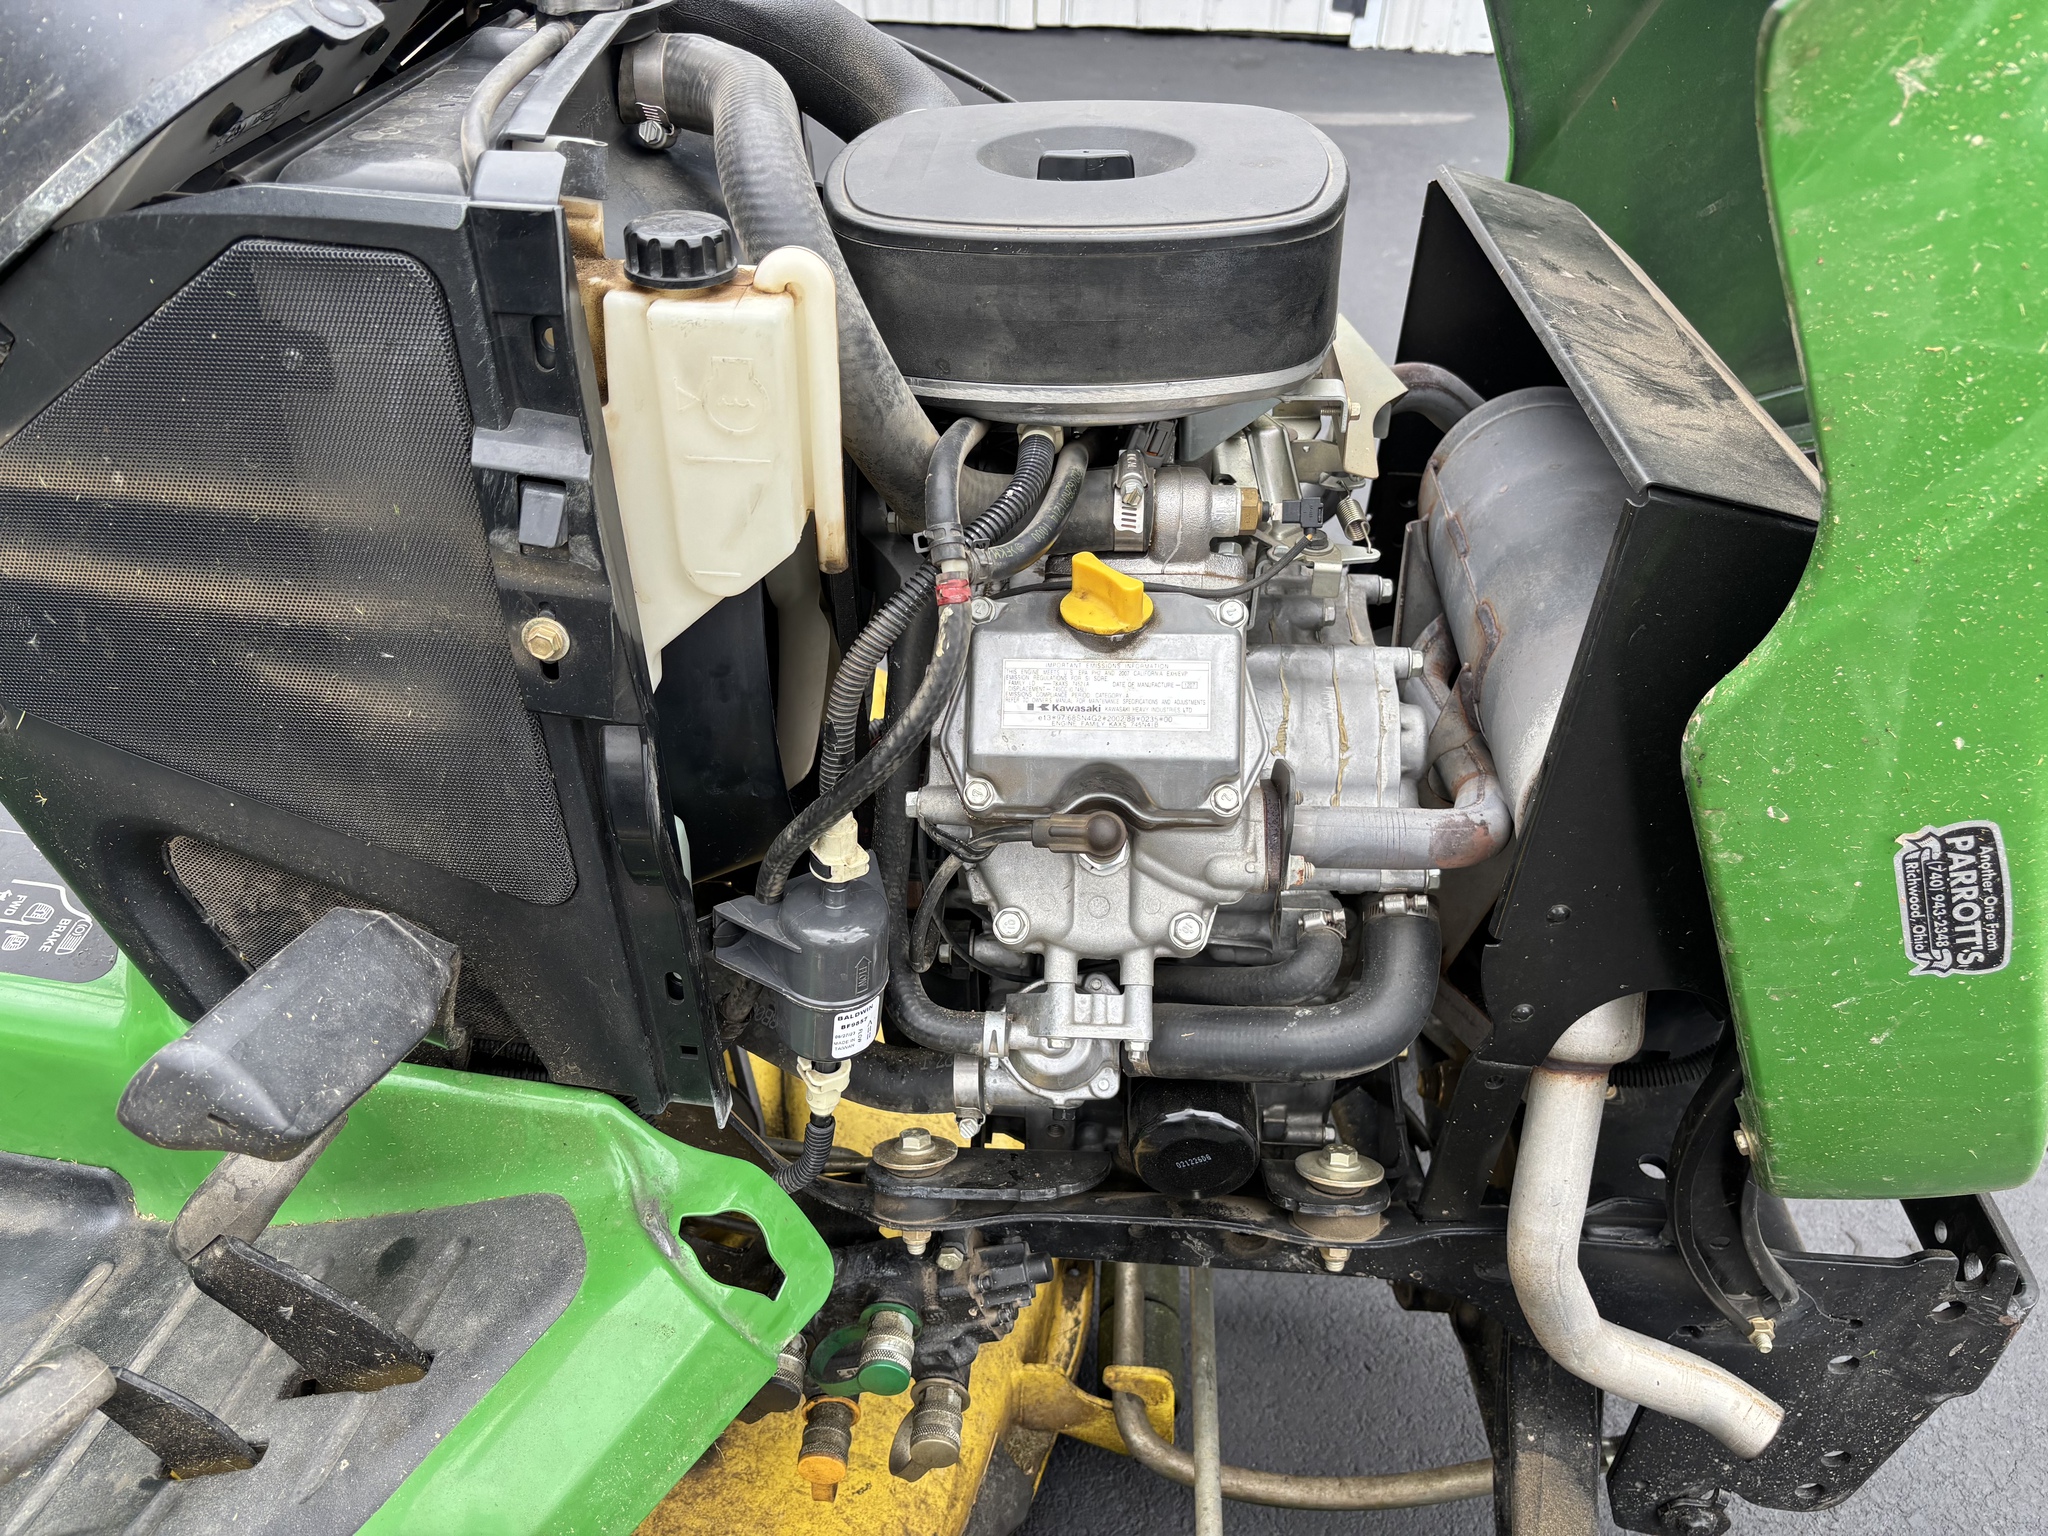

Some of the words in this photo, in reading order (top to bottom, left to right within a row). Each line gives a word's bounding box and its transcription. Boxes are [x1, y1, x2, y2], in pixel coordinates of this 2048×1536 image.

[1052, 704, 1101, 712] Kawasaki
[1926, 860, 1946, 891] (740)
[1978, 846, 1998, 896] Another
[4, 894, 28, 916] FWD
[1904, 862, 1926, 922] Richwood,
[1945, 835, 1985, 967] PARROTT'S
[1932, 894, 1950, 948] 943-2348
[1982, 896, 1998, 920] One
[38, 918, 72, 953] BRAKE
[1912, 924, 1928, 952] Ohio
[1984, 923, 2000, 950] From
[837, 1004, 874, 1022] BALDWIN
